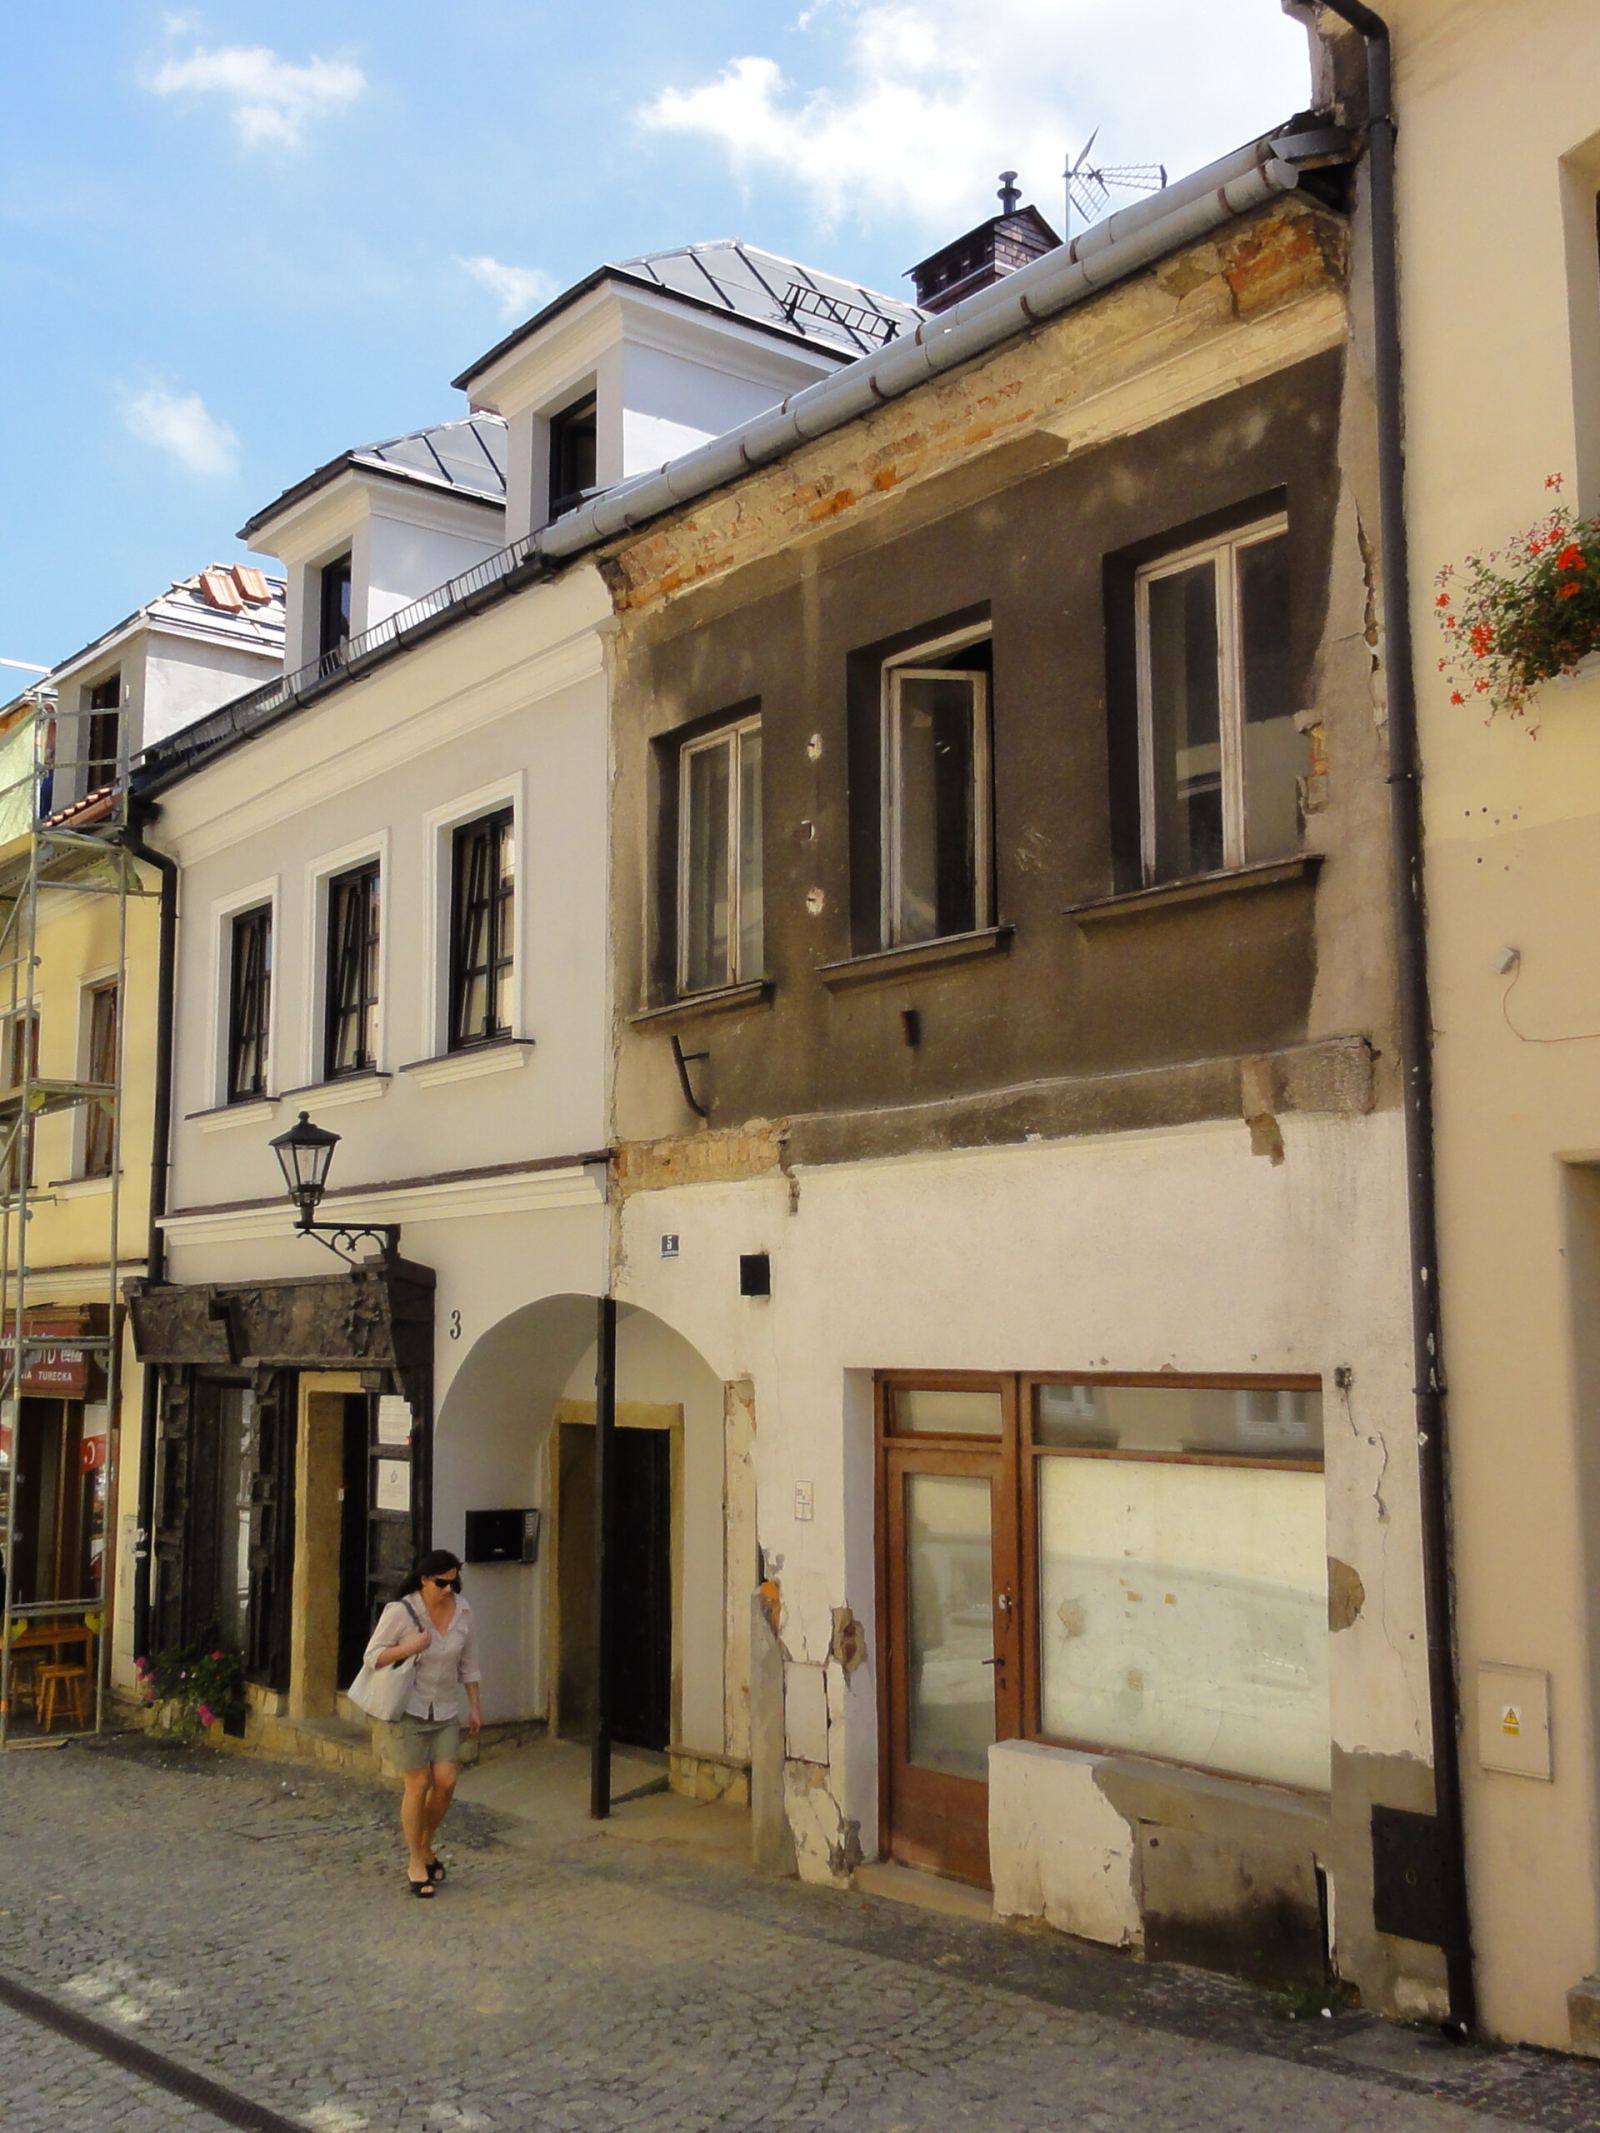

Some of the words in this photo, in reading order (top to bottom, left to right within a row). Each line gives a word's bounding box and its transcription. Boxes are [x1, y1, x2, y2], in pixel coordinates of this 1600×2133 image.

[666, 1235, 673, 1250] 5
[450, 1310, 461, 1340] 3
[38, 1370, 73, 1381] TURECKA
